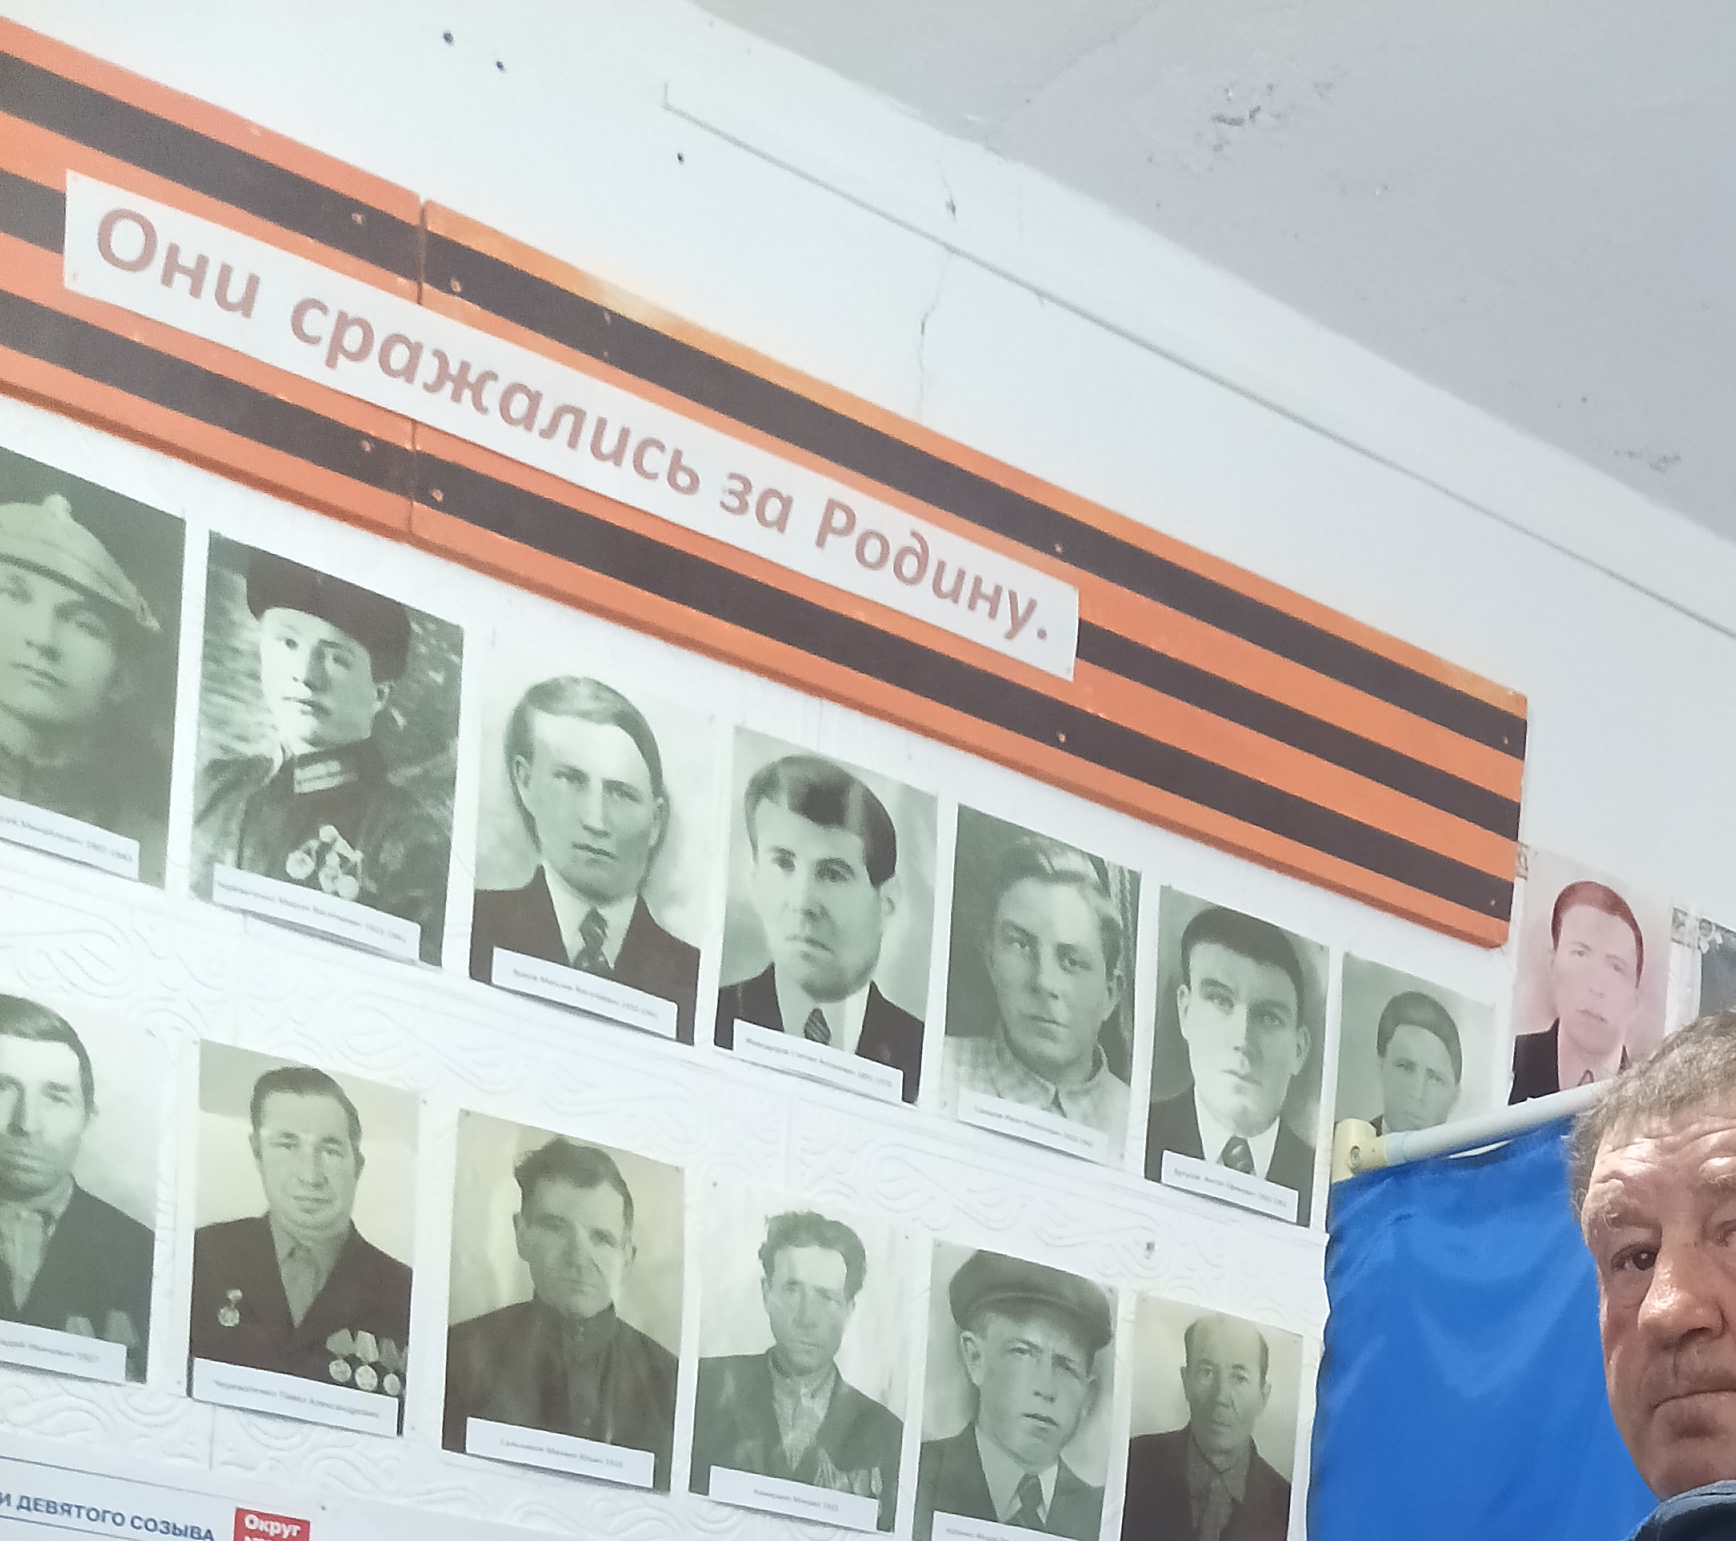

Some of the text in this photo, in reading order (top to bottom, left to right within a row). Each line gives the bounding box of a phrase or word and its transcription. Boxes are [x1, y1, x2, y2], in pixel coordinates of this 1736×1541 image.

[94, 203, 1051, 643] Они сражались за Родину.
[16, 1494, 126, 1528] ДЕВЯТОГО
[243, 1513, 302, 1538] Округ
